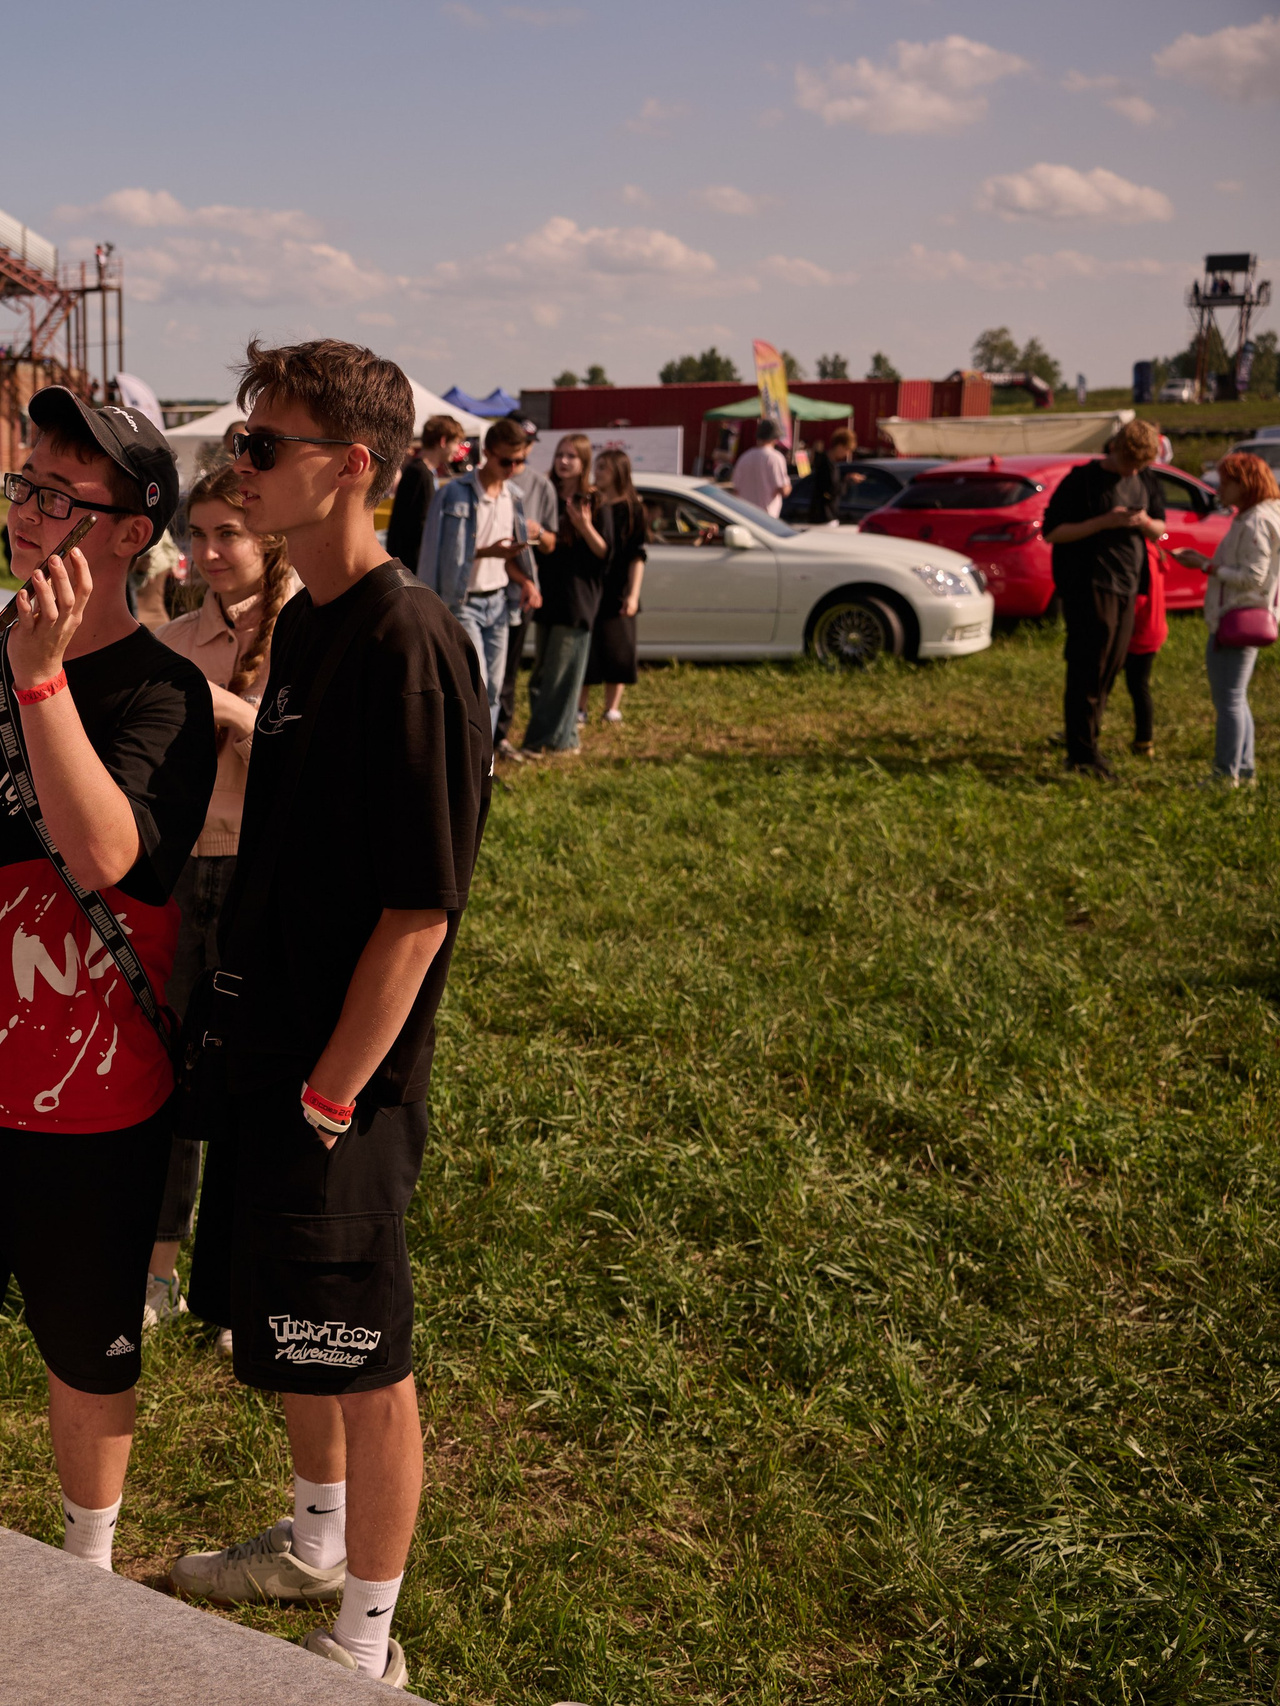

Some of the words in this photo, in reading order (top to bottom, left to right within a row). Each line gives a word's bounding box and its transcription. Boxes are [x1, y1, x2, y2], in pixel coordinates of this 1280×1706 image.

[0, 721, 20, 759] PUMA
[15, 771, 38, 809] PUMA
[88, 903, 118, 941] PUMA
[115, 945, 141, 981] PUMA
[105, 1343, 136, 1357] adidas
[268, 1314, 324, 1342] TINY
[324, 1321, 382, 1350] TOON
[275, 1341, 368, 1366] Adventures
